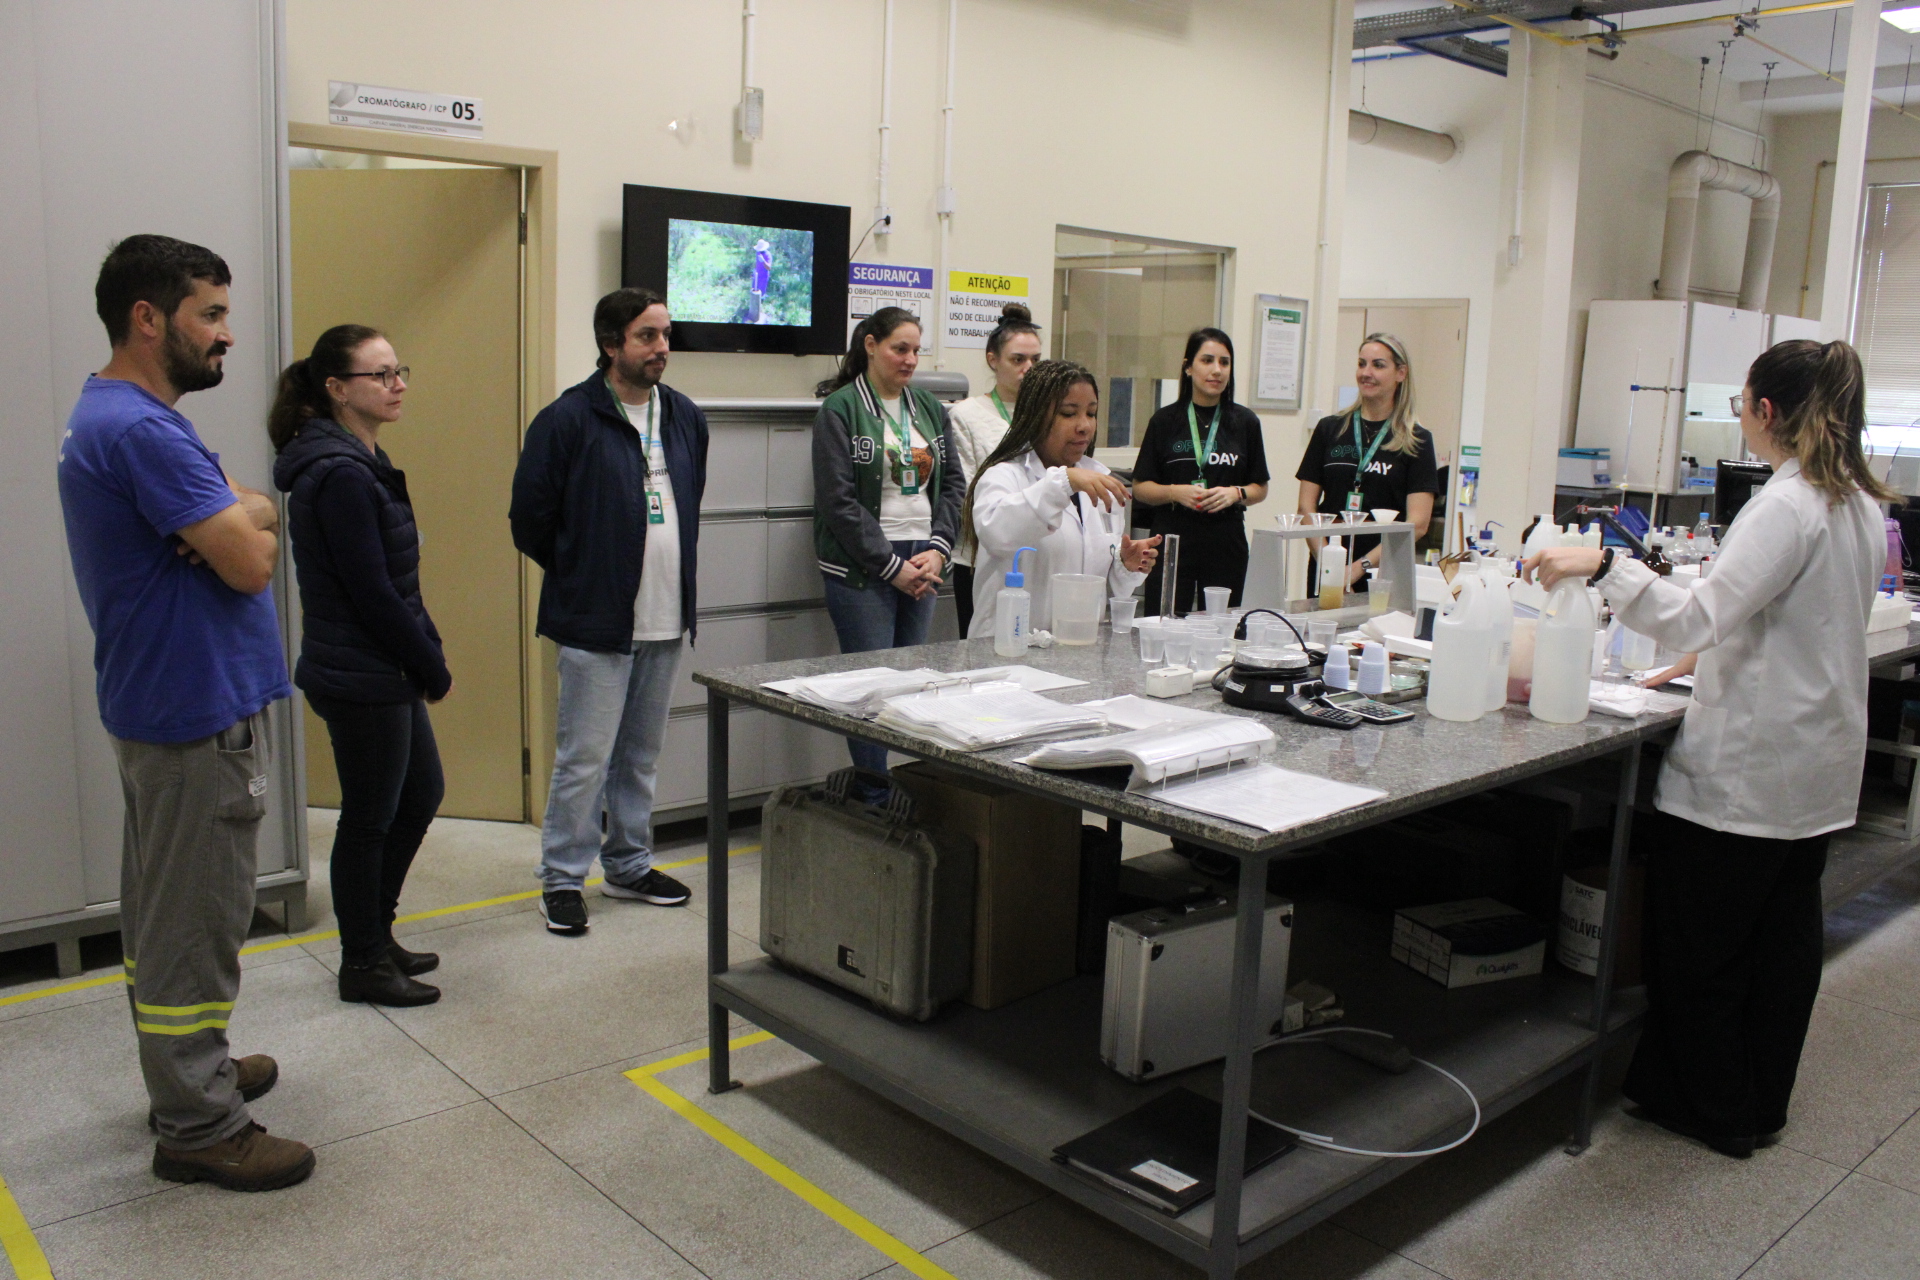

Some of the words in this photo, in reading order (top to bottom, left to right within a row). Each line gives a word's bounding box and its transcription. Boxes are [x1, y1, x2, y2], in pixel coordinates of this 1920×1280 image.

[358, 97, 427, 111] CROMATÓGRAFO
[434, 104, 447, 113] ICP
[452, 101, 475, 121] 05
[853, 266, 921, 287] SEGURANÇA
[967, 276, 1011, 293] ATENÇÃO
[854, 288, 894, 297] OBRIGATÓRIO
[895, 290, 912, 298] NESTE
[914, 291, 931, 299] LOCAL
[950, 296, 964, 306] NÃO
[966, 295, 970, 306] É
[972, 298, 1019, 308] RECOMEND
[950, 312, 963, 321] USO
[965, 313, 973, 322] DE
[949, 328, 959, 336] NO
[850, 434, 875, 464] 19
[1208, 452, 1238, 467] DAY
